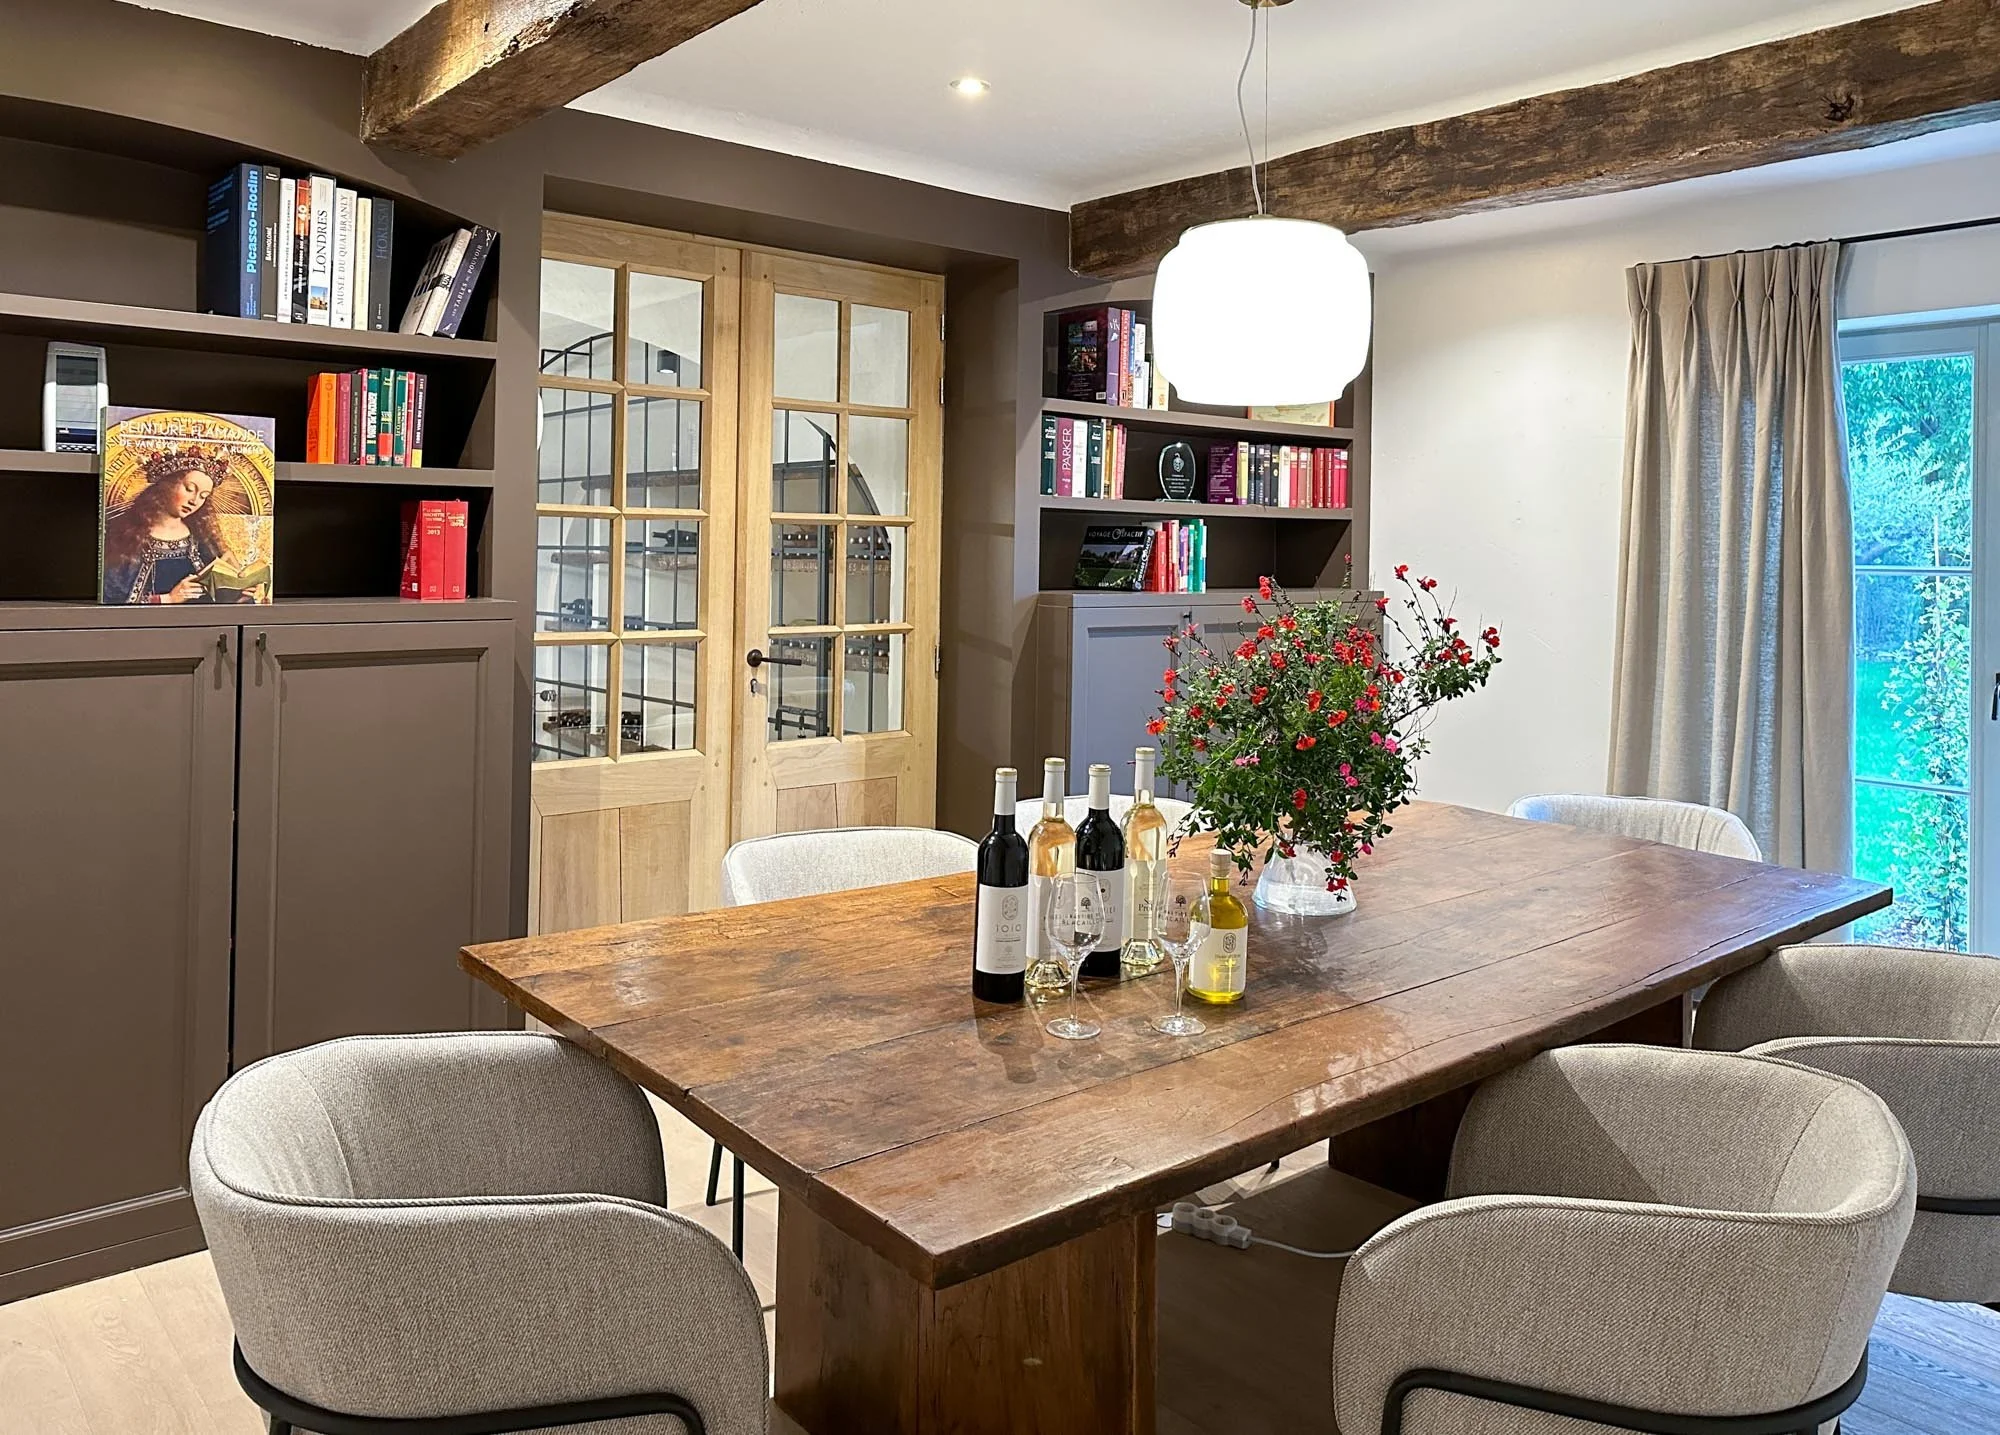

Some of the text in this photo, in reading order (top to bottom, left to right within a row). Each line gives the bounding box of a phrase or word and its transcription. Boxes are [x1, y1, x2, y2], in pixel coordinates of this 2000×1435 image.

[246, 170, 258, 274] Picasso-Rodin
[298, 204, 308, 221] 40
[312, 210, 328, 274] LONDRES
[375, 203, 389, 259] HOKUSAI
[336, 194, 348, 306] MUSÉE DU QUAI BRANLY
[454, 282, 468, 308] TABLES
[467, 244, 483, 274] POUVOIR
[120, 420, 186, 436] PEINTURE
[191, 424, 265, 442] FLAMANDE
[1062, 428, 1072, 471] PARKER
